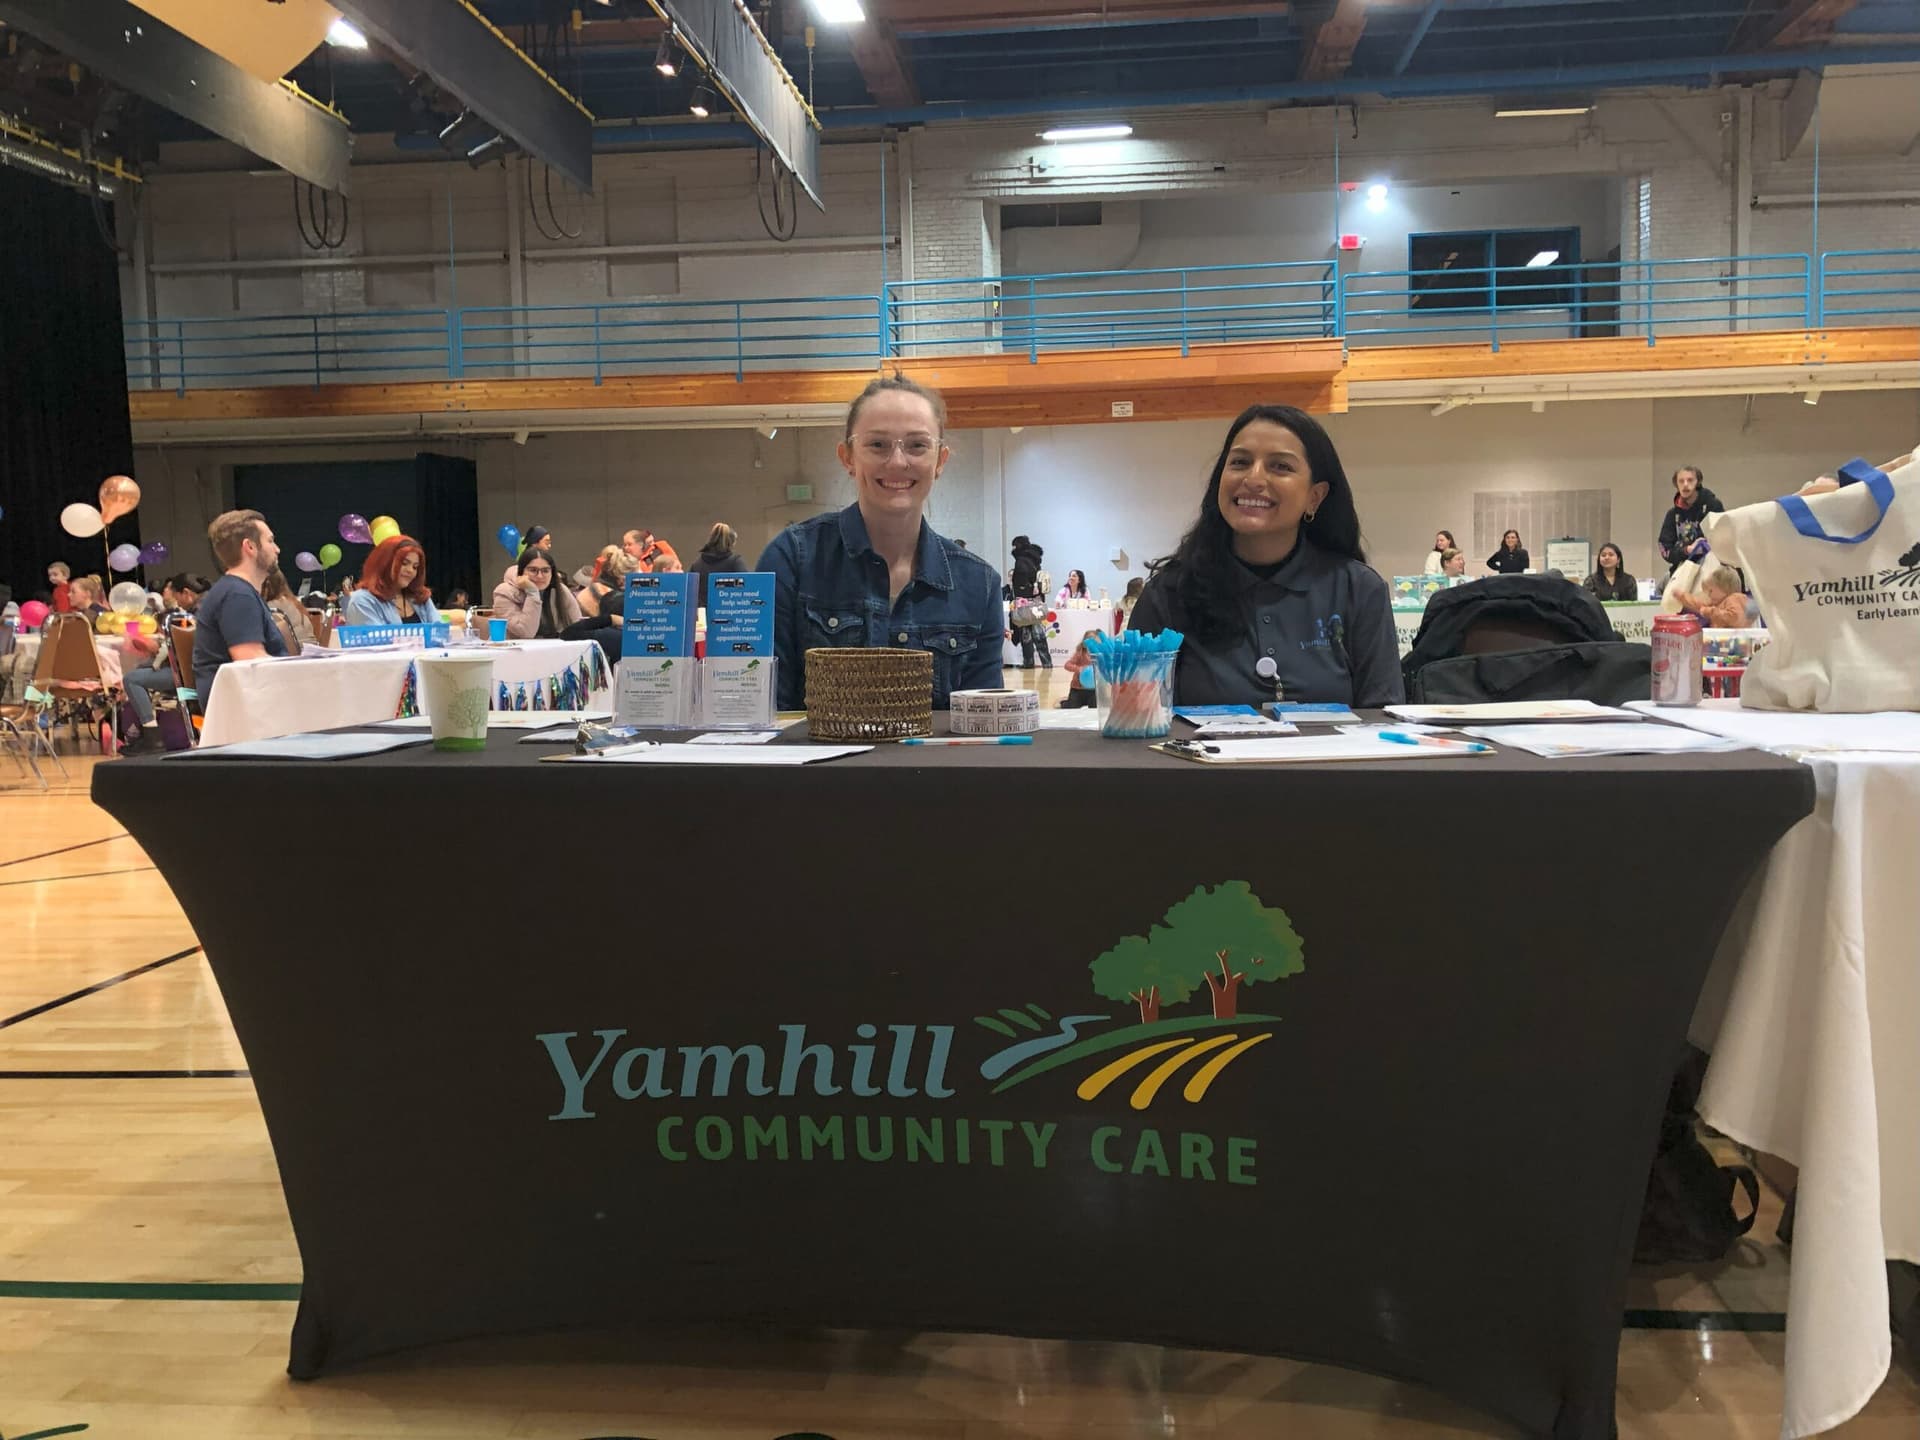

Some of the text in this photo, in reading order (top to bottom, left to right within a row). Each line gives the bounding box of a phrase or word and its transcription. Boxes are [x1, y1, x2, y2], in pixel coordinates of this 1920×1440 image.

[1793, 575, 1875, 602] Yamhill
[1817, 590, 1920, 606] COMMUNITY CA
[715, 608, 761, 616] transportation
[1857, 609, 1885, 620] Early
[1613, 619, 1645, 629] City of
[536, 1024, 955, 1121] Yamhill
[656, 1115, 1258, 1186] COMMUNITY CARE
